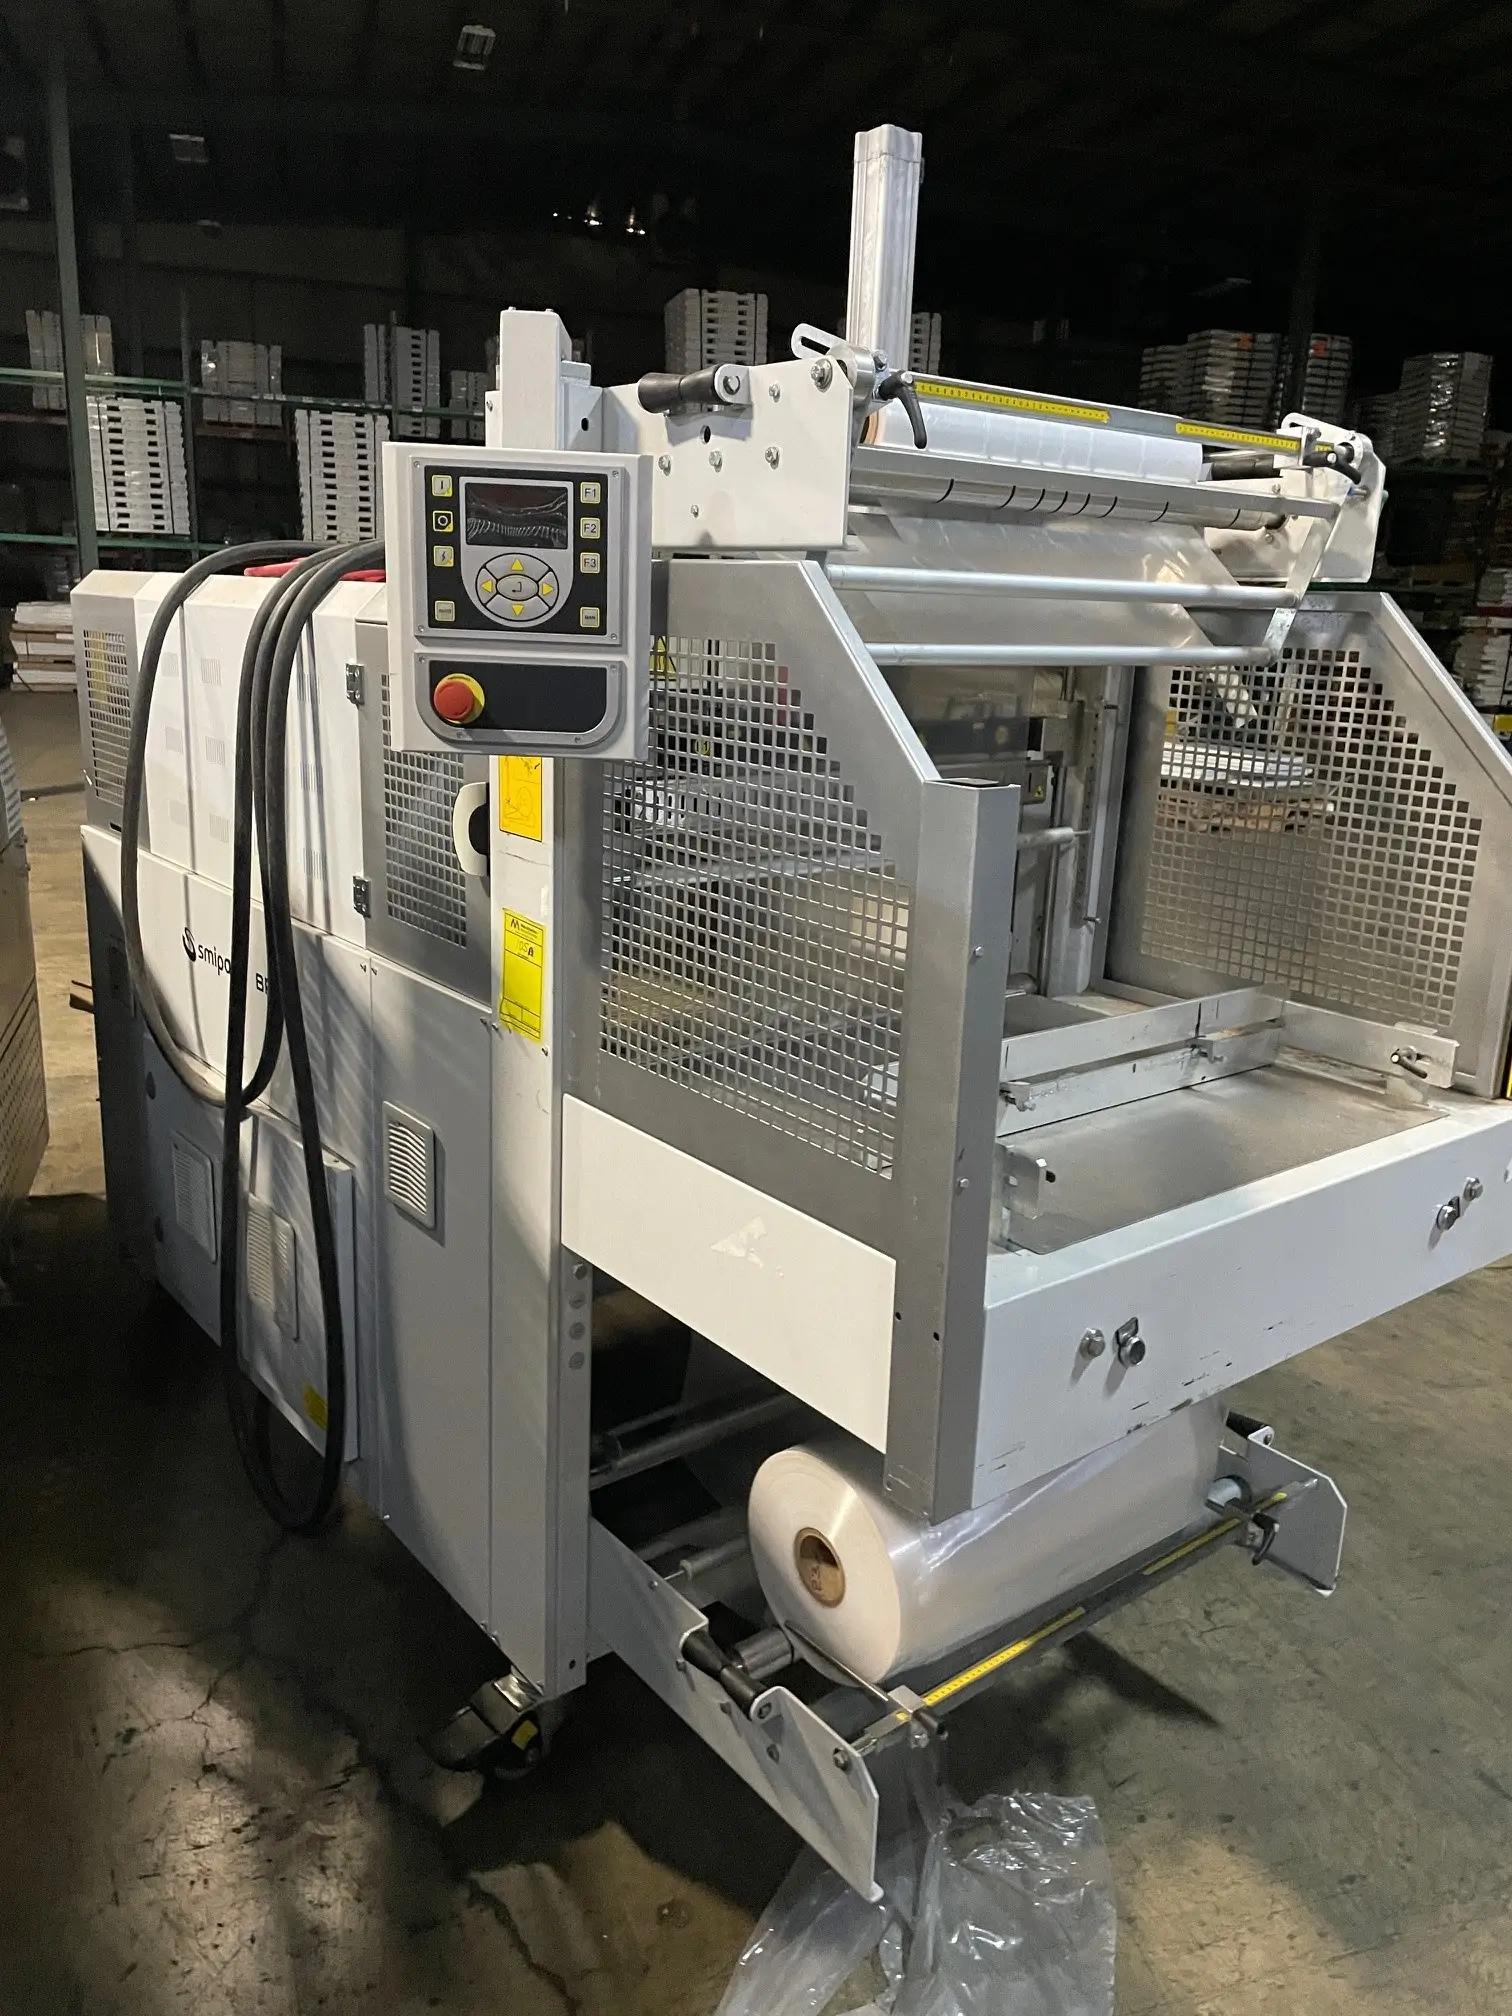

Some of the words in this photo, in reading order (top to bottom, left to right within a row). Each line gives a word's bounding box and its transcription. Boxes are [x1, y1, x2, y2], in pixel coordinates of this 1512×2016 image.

[584, 487, 596, 498] F1
[584, 523, 597, 534] F2
[584, 557, 597, 568] F3
